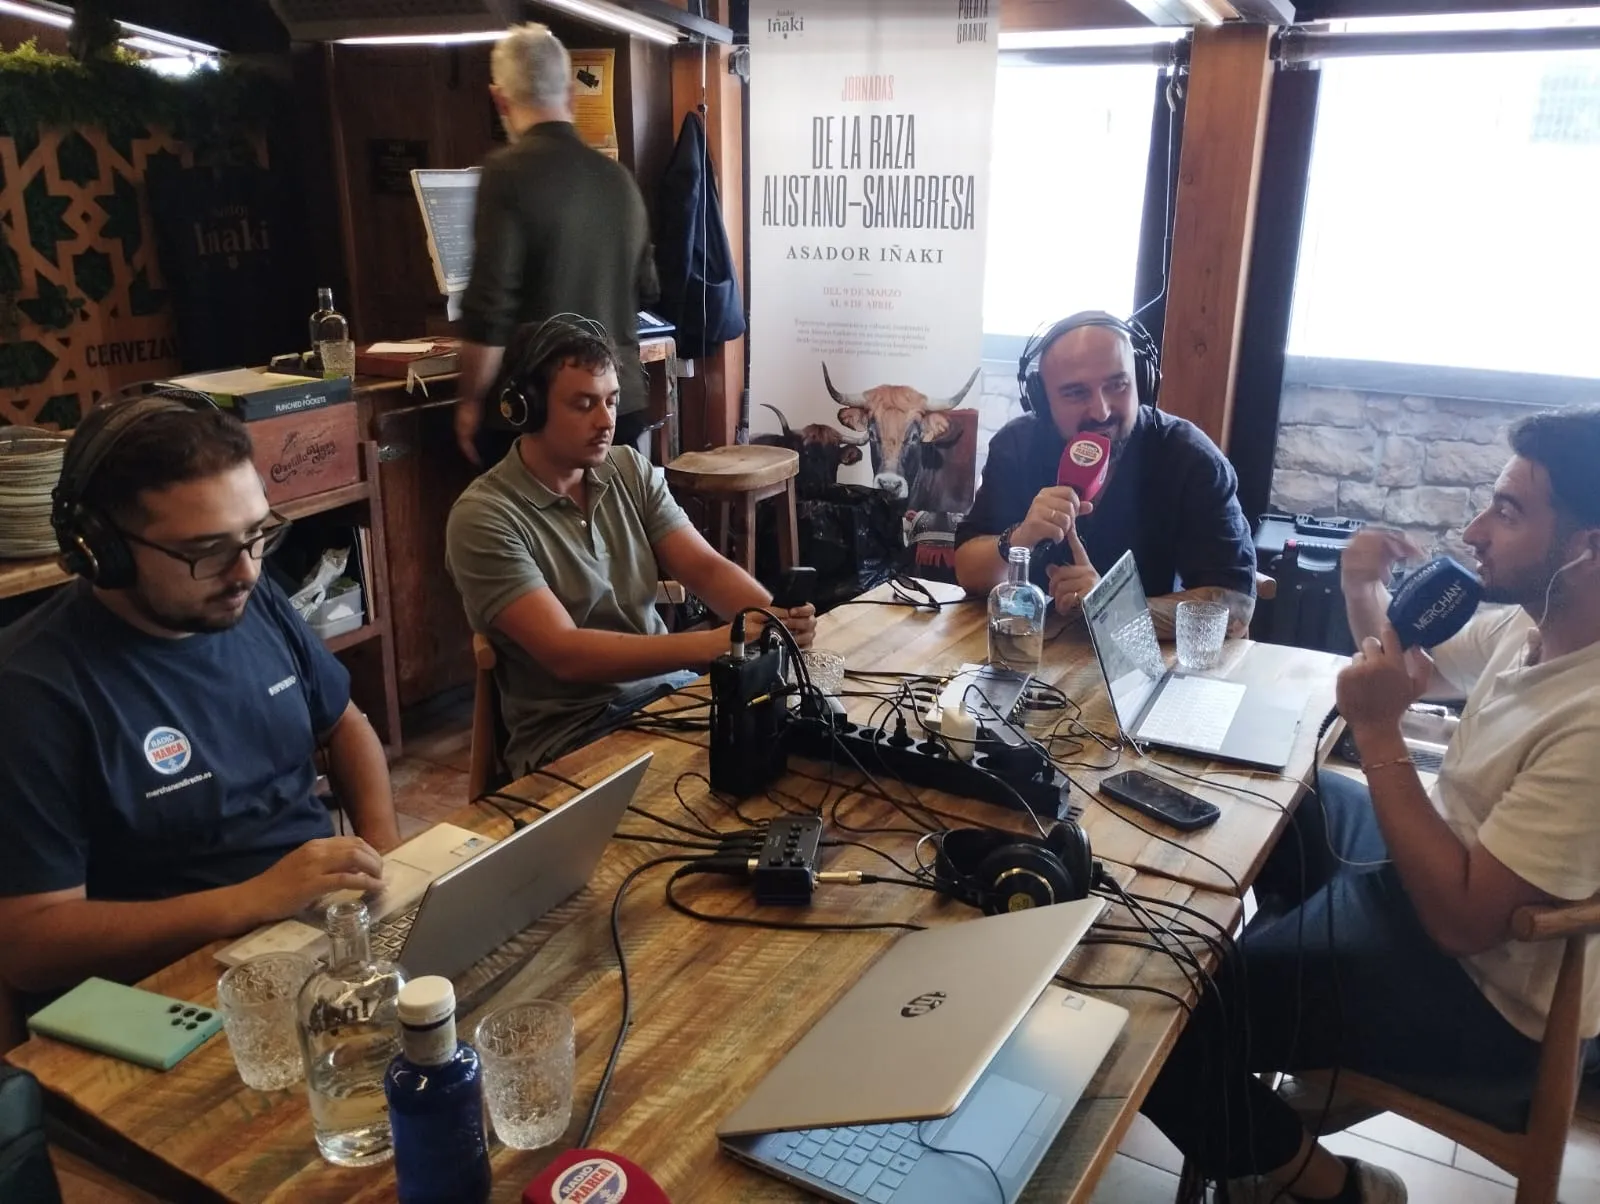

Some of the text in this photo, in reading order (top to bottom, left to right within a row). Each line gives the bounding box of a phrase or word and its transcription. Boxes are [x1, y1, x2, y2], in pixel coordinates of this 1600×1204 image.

[767, 16, 804, 33] Iñaki
[957, 22, 988, 44] GRANDE
[842, 75, 895, 102] JORNADAS
[812, 114, 916, 170] DE LA RAZA
[786, 244, 944, 263] ASADOR IÑAKI
[866, 287, 902, 298] MARZO
[275, 395, 327, 413] PUNCHED POCKETS
[150, 734, 175, 749] RADIO
[152, 742, 185, 762] MARCA
[561, 1166, 594, 1195] RADIO
[568, 1167, 612, 1204] MARCA
